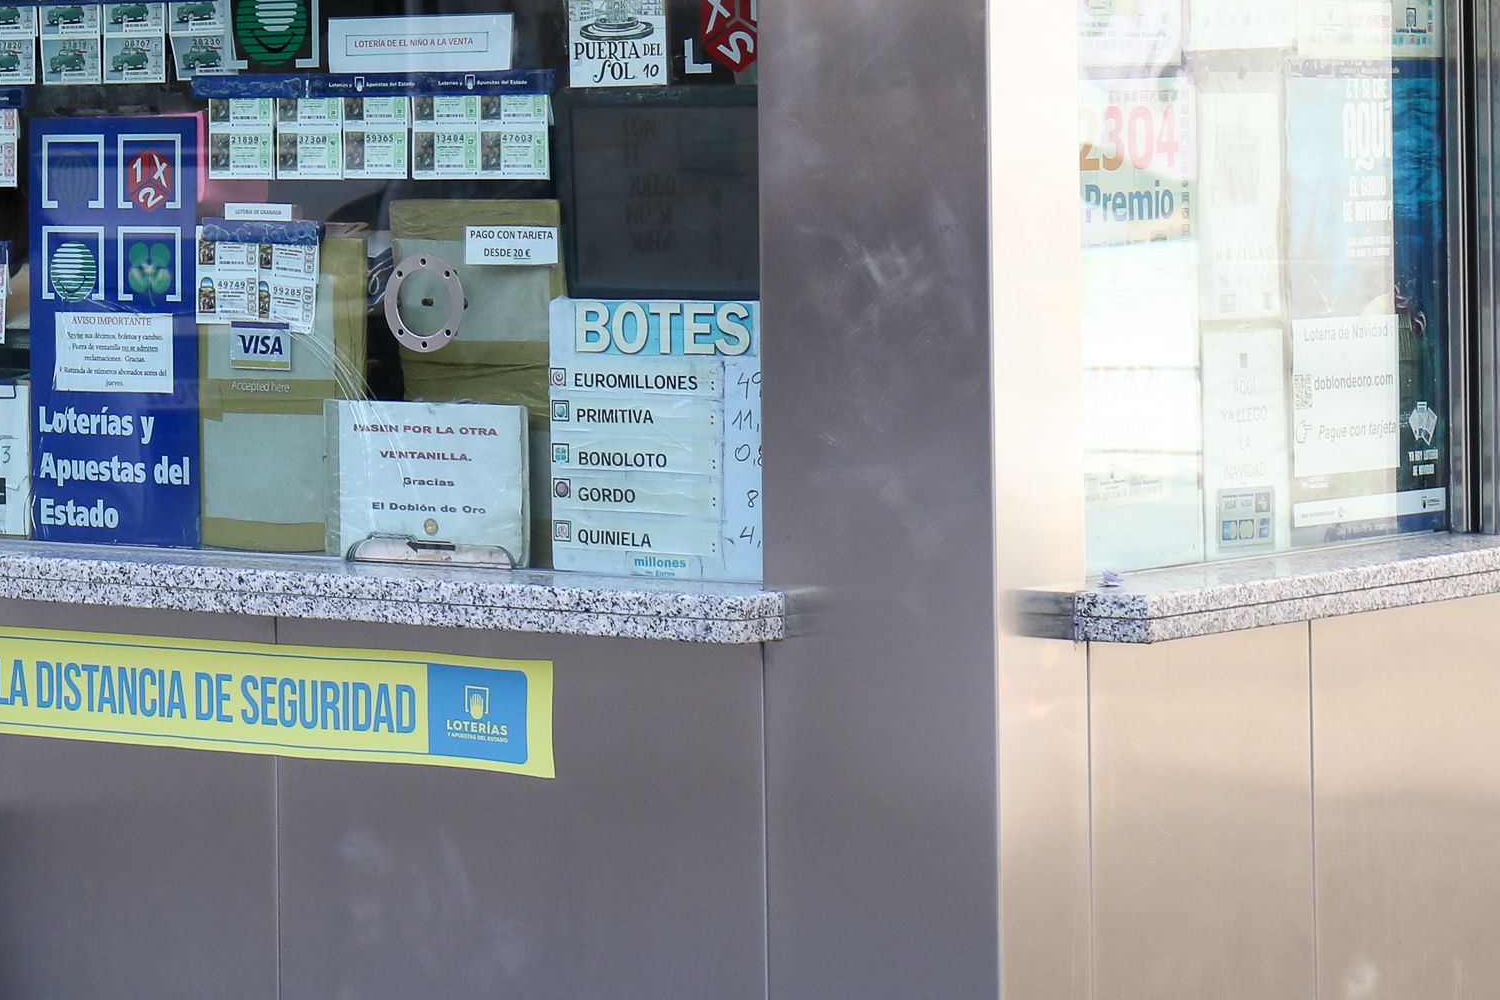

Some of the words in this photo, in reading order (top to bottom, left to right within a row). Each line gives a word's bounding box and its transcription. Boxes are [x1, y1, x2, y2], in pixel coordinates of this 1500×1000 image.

[354, 37, 385, 48] LOTERÍA
[387, 39, 397, 47] DE
[399, 38, 408, 46] EL
[410, 36, 428, 46] NIÑO
[448, 37, 473, 45] VENTA
[574, 42, 641, 60] PUERTA
[643, 43, 663, 56] DEL
[643, 64, 659, 78] 10
[299, 135, 327, 143] 37368
[366, 135, 393, 143] 59365
[436, 134, 464, 143] 13484
[502, 134, 533, 143] 47603
[1086, 179, 1174, 223] Premio
[470, 230, 494, 240] PAGO
[497, 230, 515, 240] CON
[517, 230, 553, 240] TARJETA
[484, 248, 511, 258] DESDE
[513, 248, 522, 258] 20
[523, 248, 530, 258] €
[218, 280, 245, 289] 49749
[273, 287, 301, 296] 99285
[72, 316, 96, 324] AVISO
[97, 316, 152, 326] IMPORTANTE
[575, 302, 751, 355] BOTES
[1338, 326, 1349, 340] de
[1352, 325, 1387, 338] Navidad
[238, 334, 283, 355] VISA
[231, 380, 268, 393] Accepted
[270, 381, 290, 393] here
[574, 373, 698, 390] EUROMILLONES
[1314, 373, 1393, 390] doblondeoro.com
[577, 409, 654, 425] PRIMITIVA
[39, 406, 133, 436] Loterías
[140, 414, 155, 444] y
[353, 424, 398, 433] PASEN
[403, 424, 431, 434] POR
[436, 426, 455, 435] LA
[459, 426, 498, 436] OTRA
[1318, 424, 1347, 442] Pague
[1350, 425, 1366, 437] con
[1369, 420, 1396, 436] tarjeta
[380, 450, 472, 462] VENTANILLA.
[578, 452, 667, 468] BONOLOTO
[39, 453, 146, 486] Apuestas
[154, 456, 190, 485] del
[403, 477, 455, 488] Gracias
[578, 488, 635, 503] GORDO
[747, 490, 759, 507] 8
[40, 499, 119, 528] Estado
[372, 502, 385, 511] El
[389, 502, 436, 513] Doblón
[441, 504, 457, 513] de
[462, 505, 486, 515] Oro
[577, 529, 651, 548] QUINIELA
[634, 557, 686, 568] millones
[36, 660, 186, 719] DISTANCIA
[196, 669, 234, 723] DE
[240, 672, 417, 735] SEGURIDAD
[447, 719, 508, 736] LOTERÍAS
